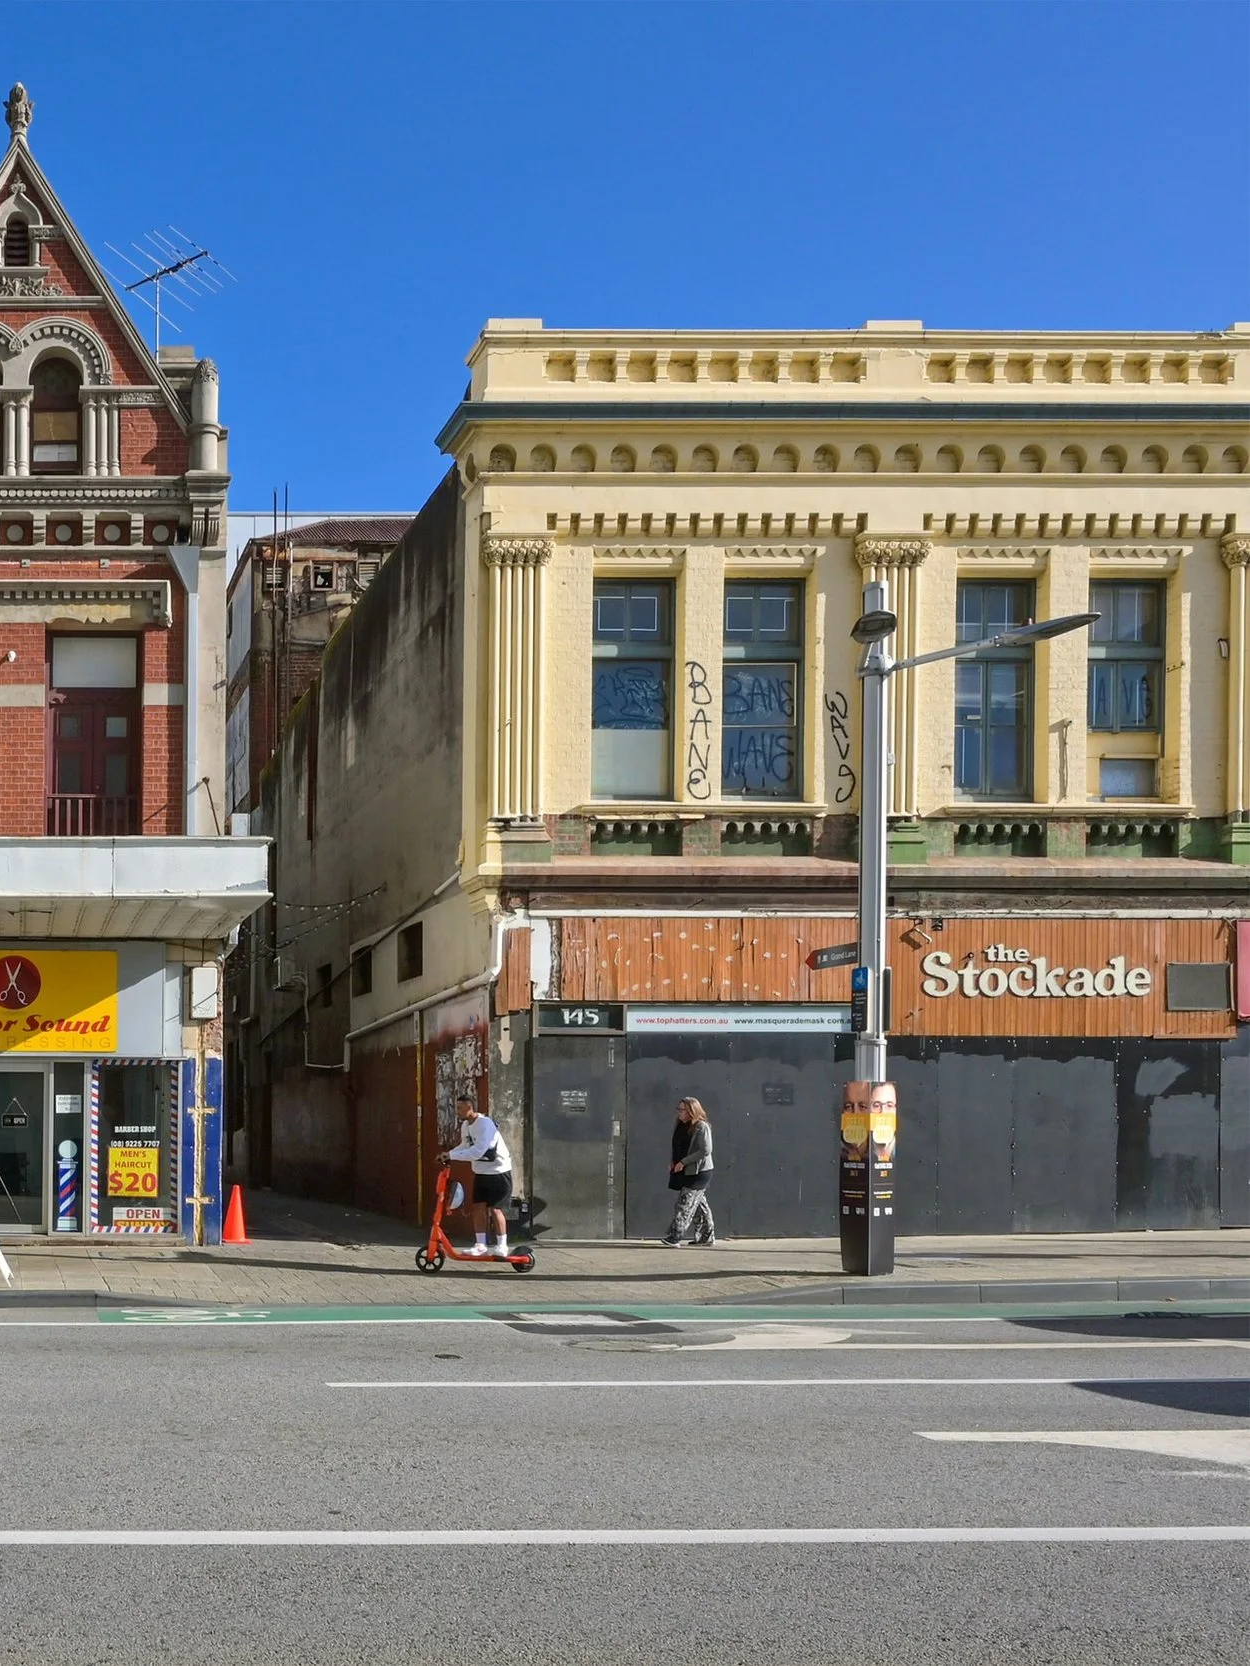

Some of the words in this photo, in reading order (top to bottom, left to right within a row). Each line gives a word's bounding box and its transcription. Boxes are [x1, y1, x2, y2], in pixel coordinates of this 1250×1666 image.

[985, 944, 1029, 962] the
[922, 951, 1151, 998] Stockade
[22, 1014, 111, 1034] Sound
[561, 1008, 600, 1025] 145
[636, 1017, 729, 1026] www.tophatters.com.au
[109, 1171, 157, 1194] $20
[126, 1209, 160, 1218] OPEN
